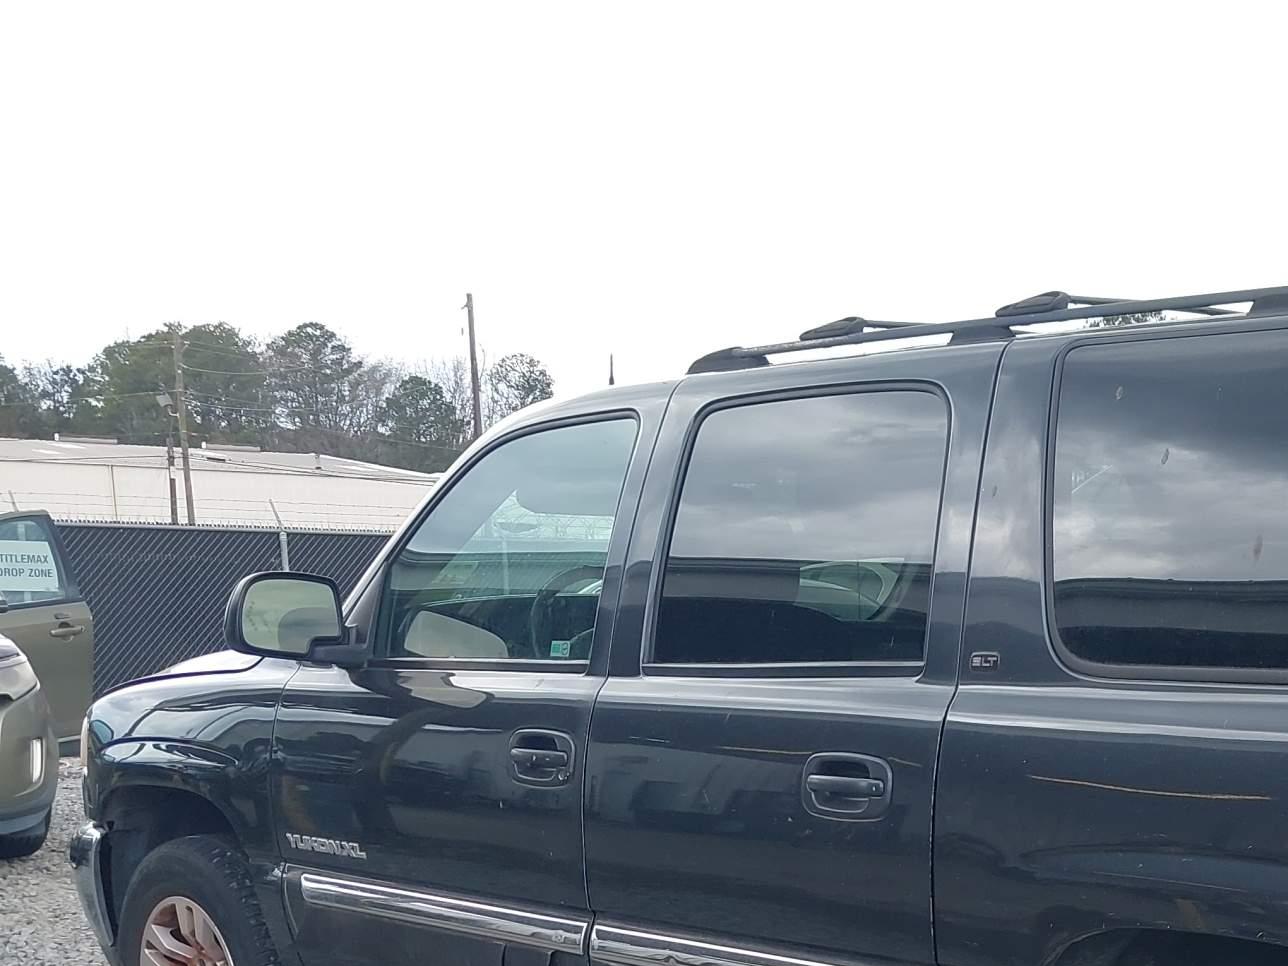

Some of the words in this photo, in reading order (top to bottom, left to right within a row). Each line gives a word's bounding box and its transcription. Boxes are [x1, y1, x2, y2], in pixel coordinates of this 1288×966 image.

[0, 554, 49, 564] TITLEMAX
[28, 568, 54, 578] ZONE
[972, 656, 997, 666] SLT
[286, 832, 341, 855] YUKON
[341, 841, 367, 859] XL
